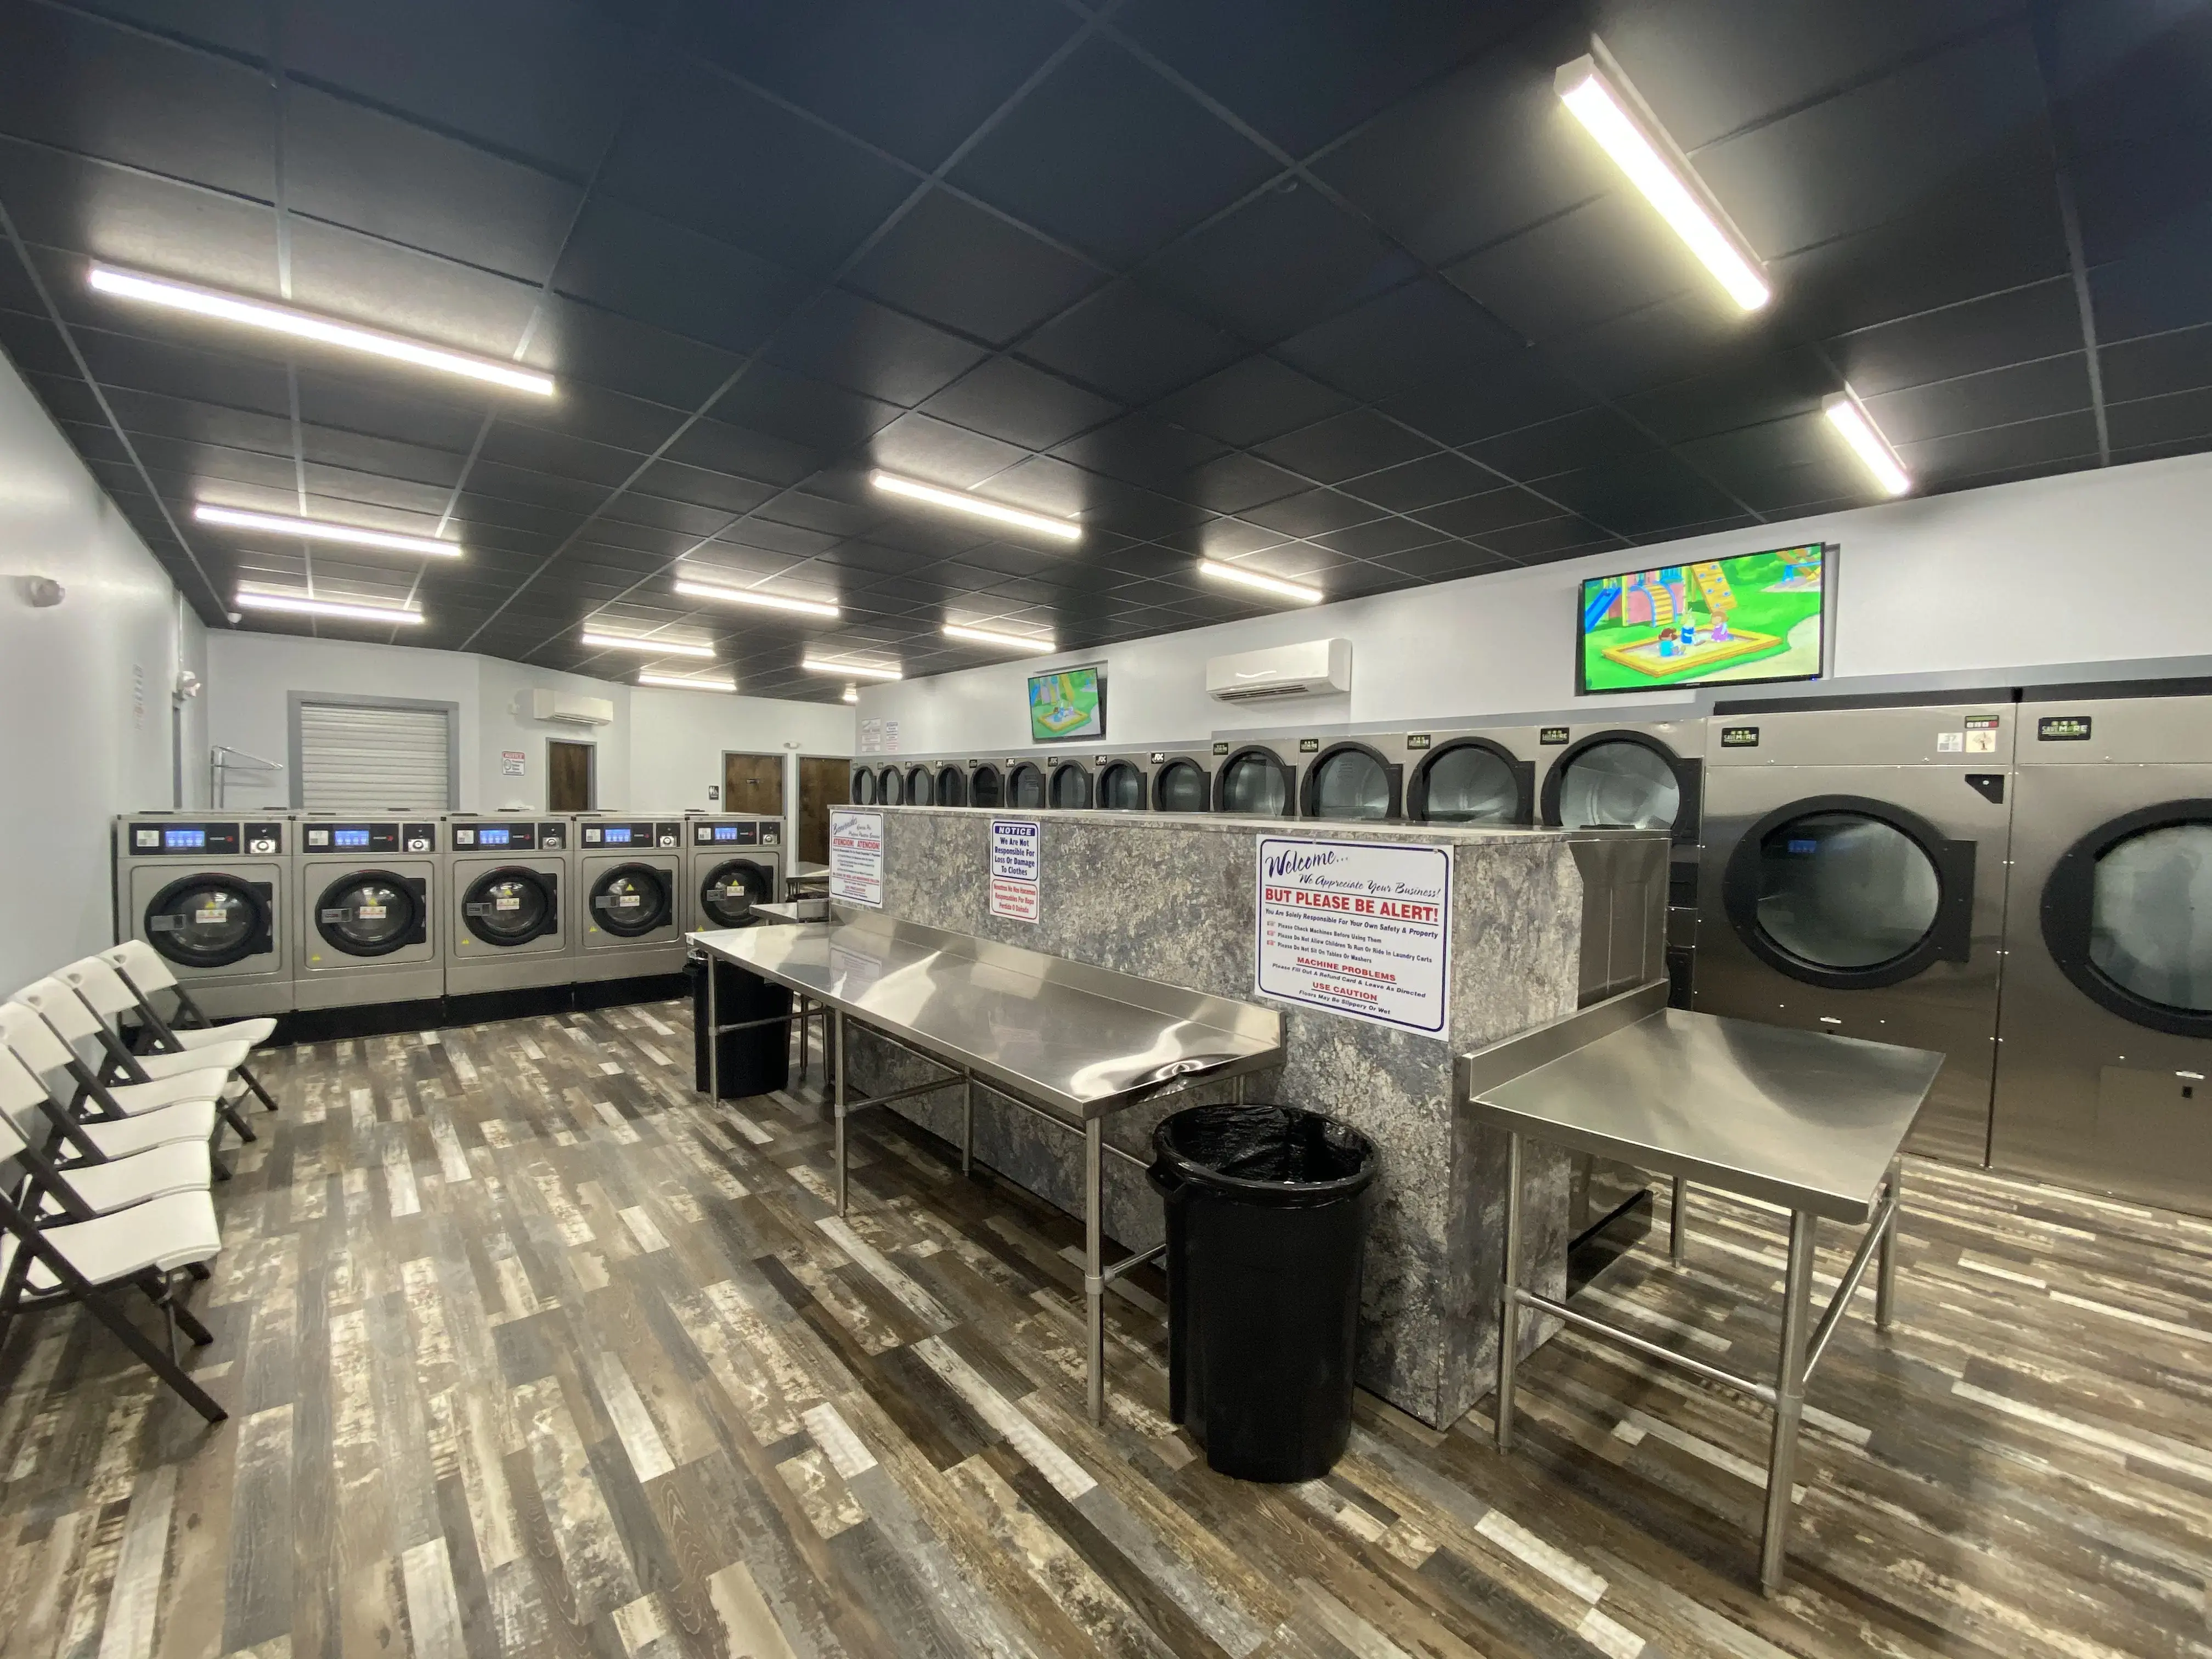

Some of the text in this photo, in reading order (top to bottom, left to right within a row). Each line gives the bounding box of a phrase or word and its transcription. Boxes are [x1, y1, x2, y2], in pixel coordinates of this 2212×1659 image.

[998, 827, 1031, 836] NOTICE
[995, 846, 1024, 856] Responsible
[1008, 867, 1028, 876] Clothes
[1014, 857, 1035, 868] Damage
[1265, 850, 1348, 878] Welcome...
[1299, 873, 1441, 898] We Appreciate Your Business!
[1266, 888, 1438, 922] BUT PLEASE BE ALERT!
[1286, 911, 1302, 919] Solely
[1303, 913, 1336, 923] Responsible
[1380, 924, 1400, 934] Safety
[1409, 928, 1438, 939] Property
[1310, 928, 1332, 936] Machines
[1351, 934, 1365, 942] Using
[1325, 940, 1346, 948] Children
[1393, 951, 1415, 961] Laundry
[1351, 955, 1372, 963] Washers
[1297, 957, 1396, 981] MACHINE PROBLEMS
[1313, 981, 1378, 1001] USE CAUTION
[1319, 972, 1340, 980] Refund
[1365, 981, 1384, 989] Leave
[1397, 988, 1426, 998] Directed
[1299, 990, 1317, 998] Floors
[1341, 998, 1367, 1010] Slippery
